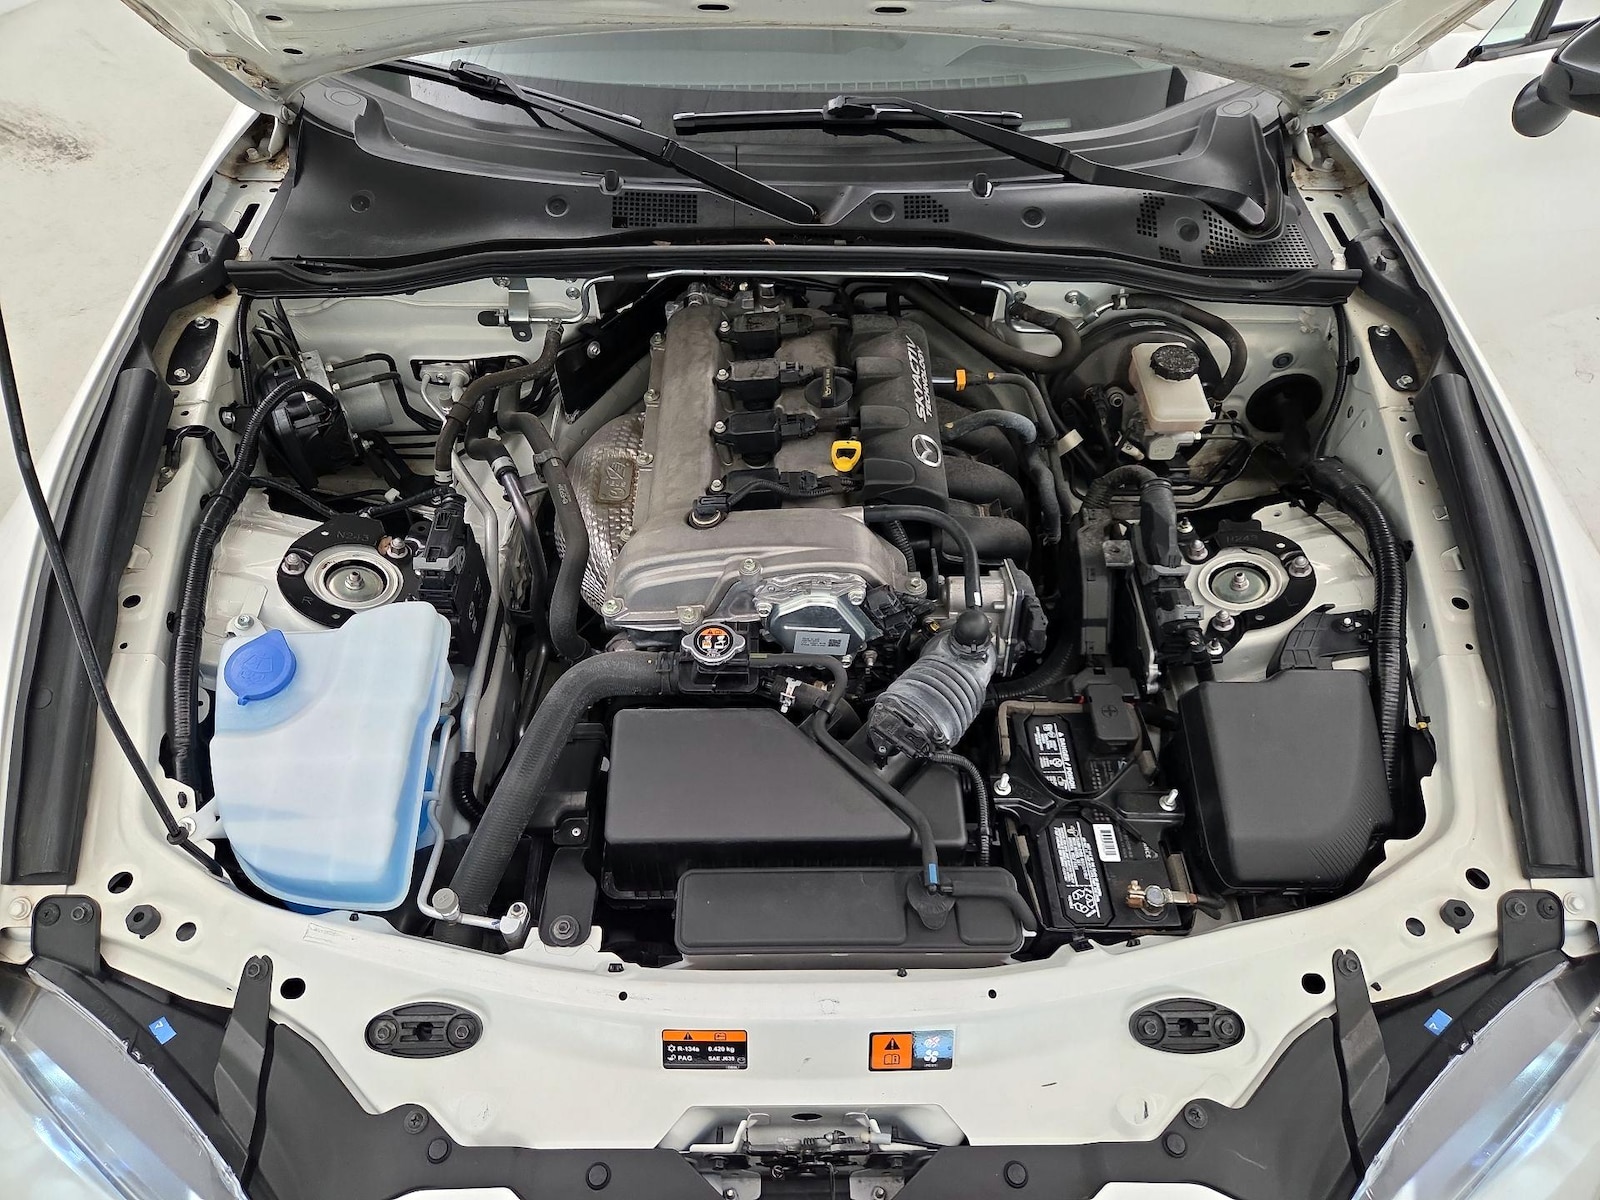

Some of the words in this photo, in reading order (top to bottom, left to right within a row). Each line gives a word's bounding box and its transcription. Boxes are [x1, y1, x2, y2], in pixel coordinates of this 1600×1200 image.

[905, 334, 927, 423] SKYACTIV
[917, 345, 933, 418] TECHNOLOGY
[1060, 737, 1070, 762] DANGER
[1066, 766, 1077, 790] POISON
[677, 1045, 700, 1053] R-134a
[726, 1046, 735, 1054] kg
